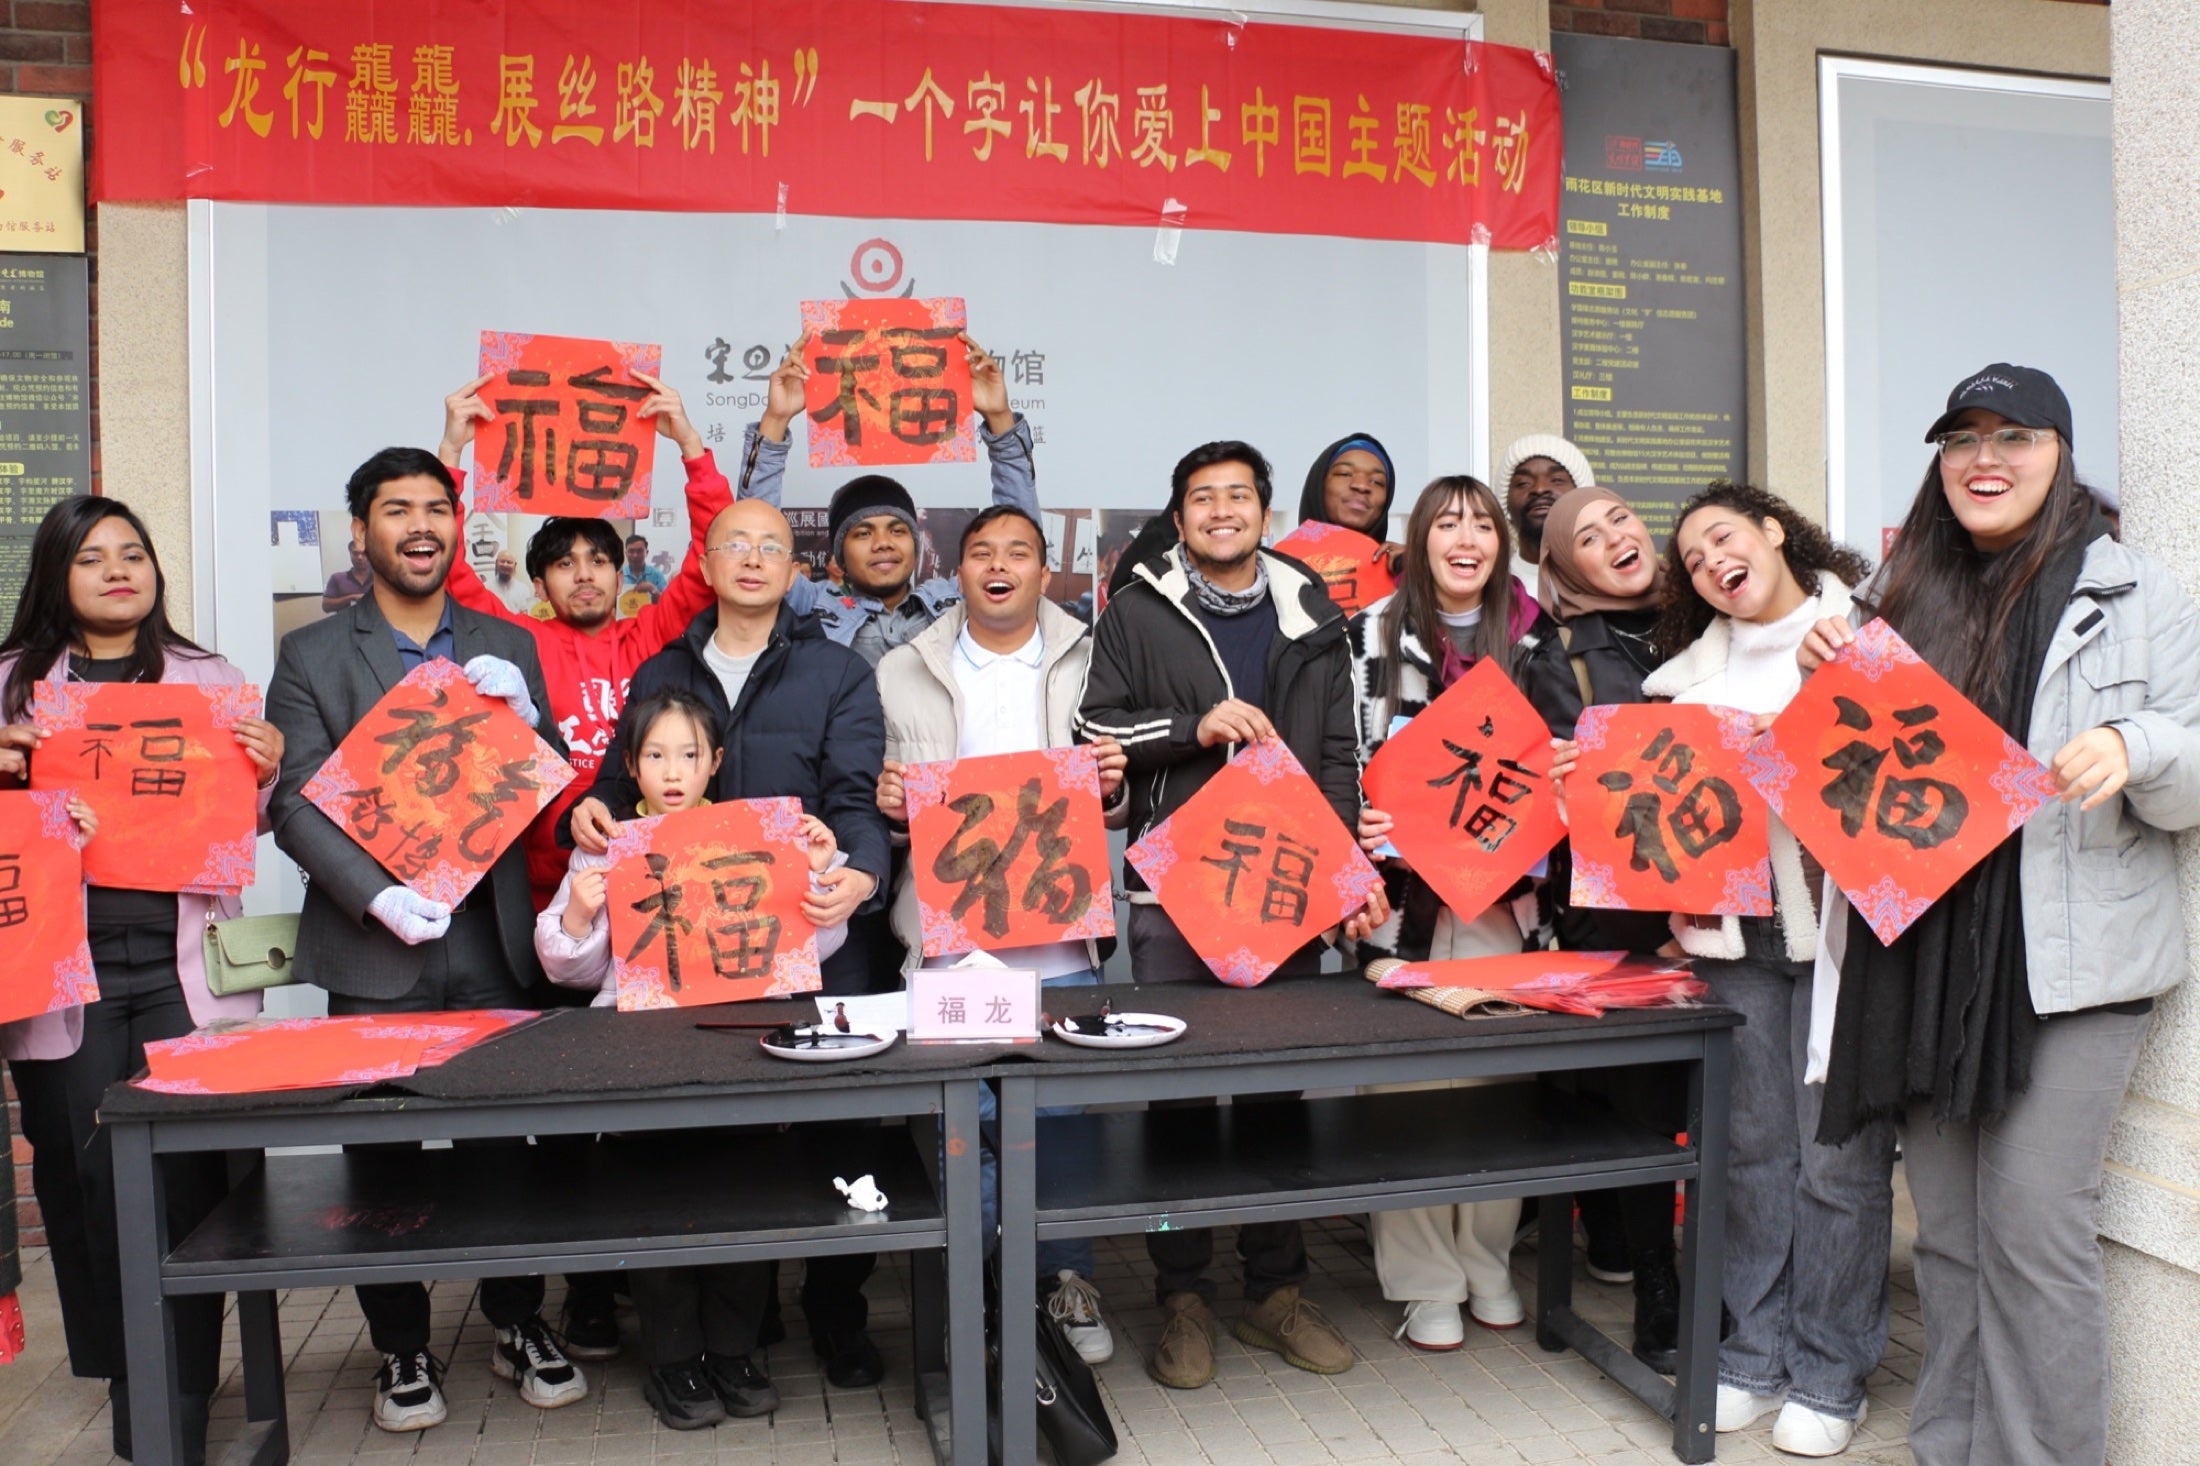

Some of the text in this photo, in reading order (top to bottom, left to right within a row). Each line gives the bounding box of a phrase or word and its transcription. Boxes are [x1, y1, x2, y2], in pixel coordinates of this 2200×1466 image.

[0, 136, 62, 181] 服务站
[850, 67, 1529, 195] 一个字让你爱上中国主题活动
[1566, 177, 1723, 203] 雨花区新时代文明实践基地
[1617, 203, 1670, 220] 工作制度
[0, 317, 14, 328] de
[705, 337, 791, 384] 宋旦
[811, 328, 965, 447] 福
[1010, 399, 1045, 409] eum
[1573, 387, 1608, 400] 工作制度
[495, 366, 654, 501] 福
[706, 423, 726, 442] 培
[80, 718, 187, 797] 福
[1427, 715, 1542, 853] 福
[1820, 695, 1970, 849] 福
[1598, 727, 1743, 884] 福
[932, 777, 1093, 939] 福
[1200, 817, 1319, 927] 福
[625, 851, 782, 992] 福
[938, 995, 1013, 1025] 福 龙
